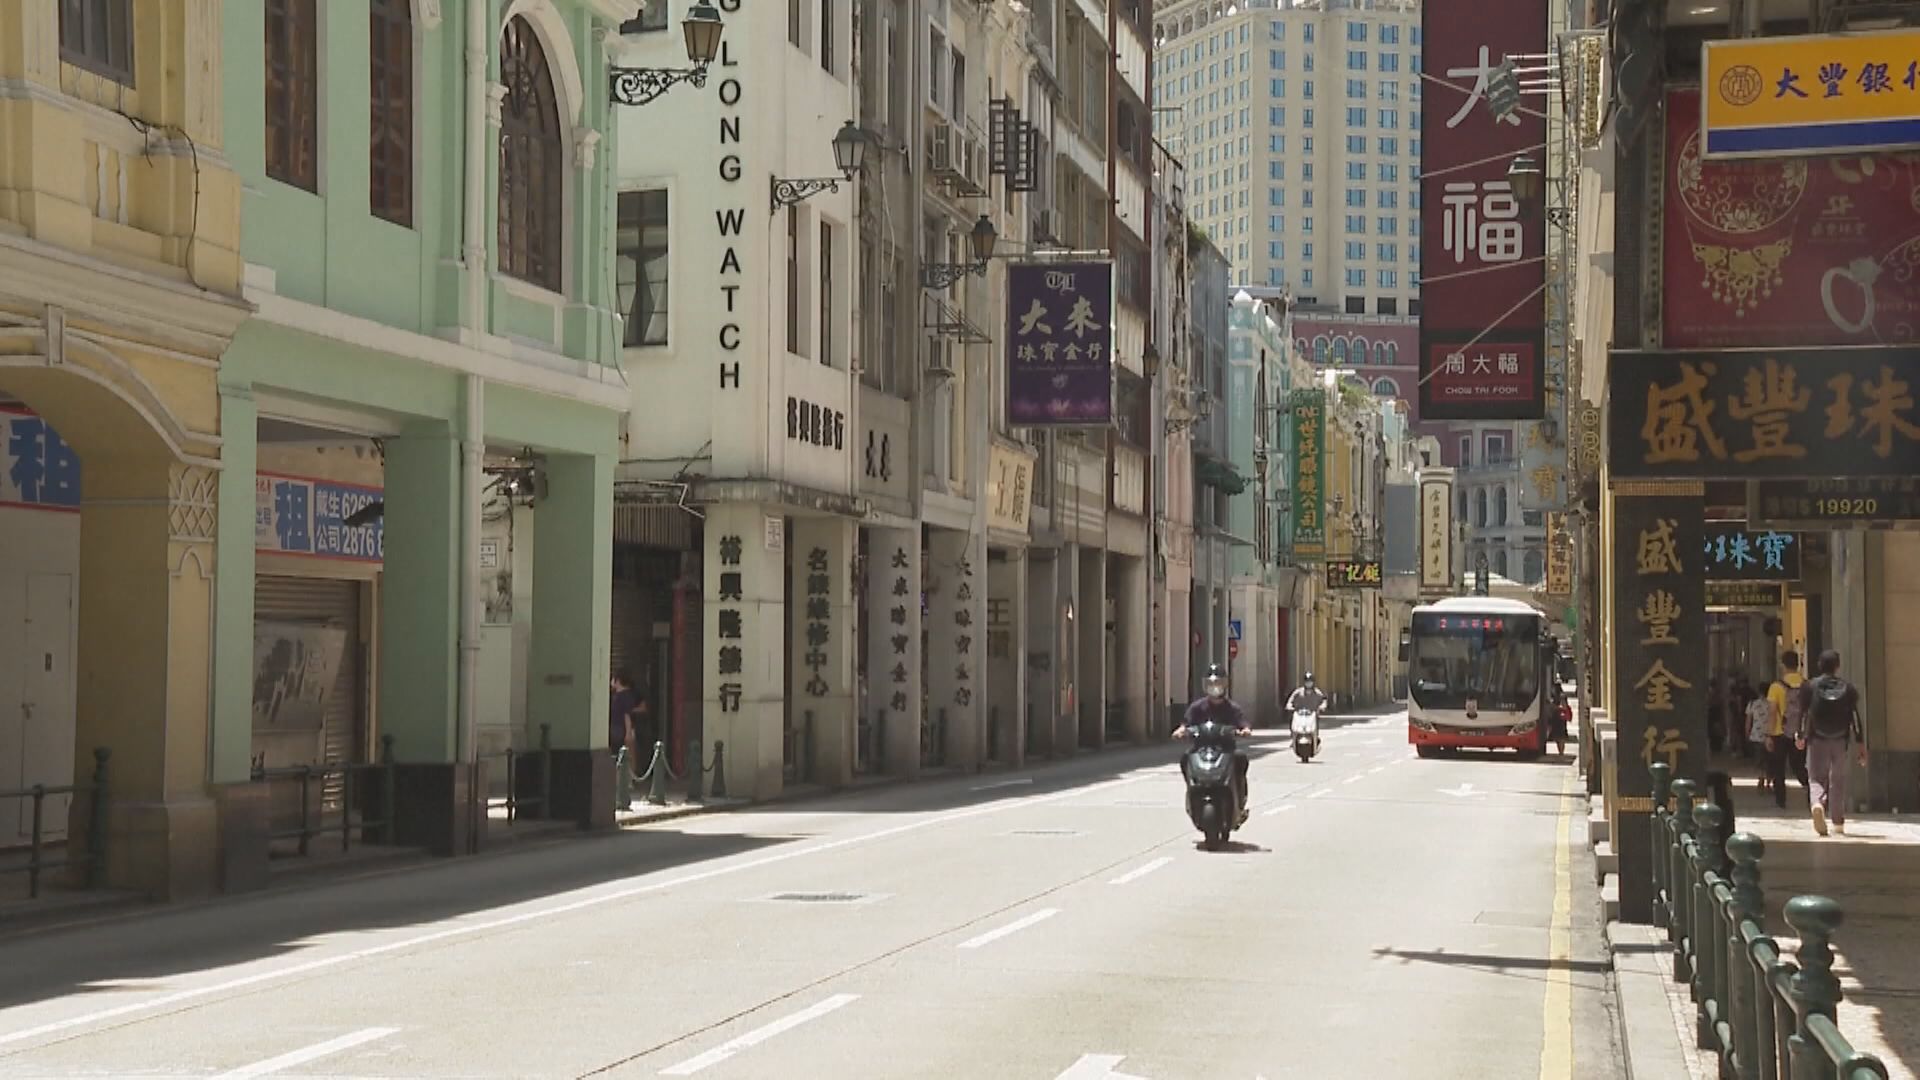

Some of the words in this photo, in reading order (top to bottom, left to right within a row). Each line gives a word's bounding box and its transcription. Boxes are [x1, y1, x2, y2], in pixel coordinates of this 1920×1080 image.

[719, 41, 741, 182] LONG
[1442, 45, 1523, 263] 大福
[716, 209, 745, 389] WATCH
[1445, 353, 1519, 375] 周大福
[1445, 386, 1472, 394] CHOW
[1475, 386, 1489, 394] TAI
[1492, 386, 1518, 394] FOOK
[275, 481, 310, 550] 租
[1816, 499, 1877, 514] 19920
[316, 523, 340, 552] 公司
[342, 526, 375, 556] 2876
[1704, 529, 1793, 570] 珠寶
